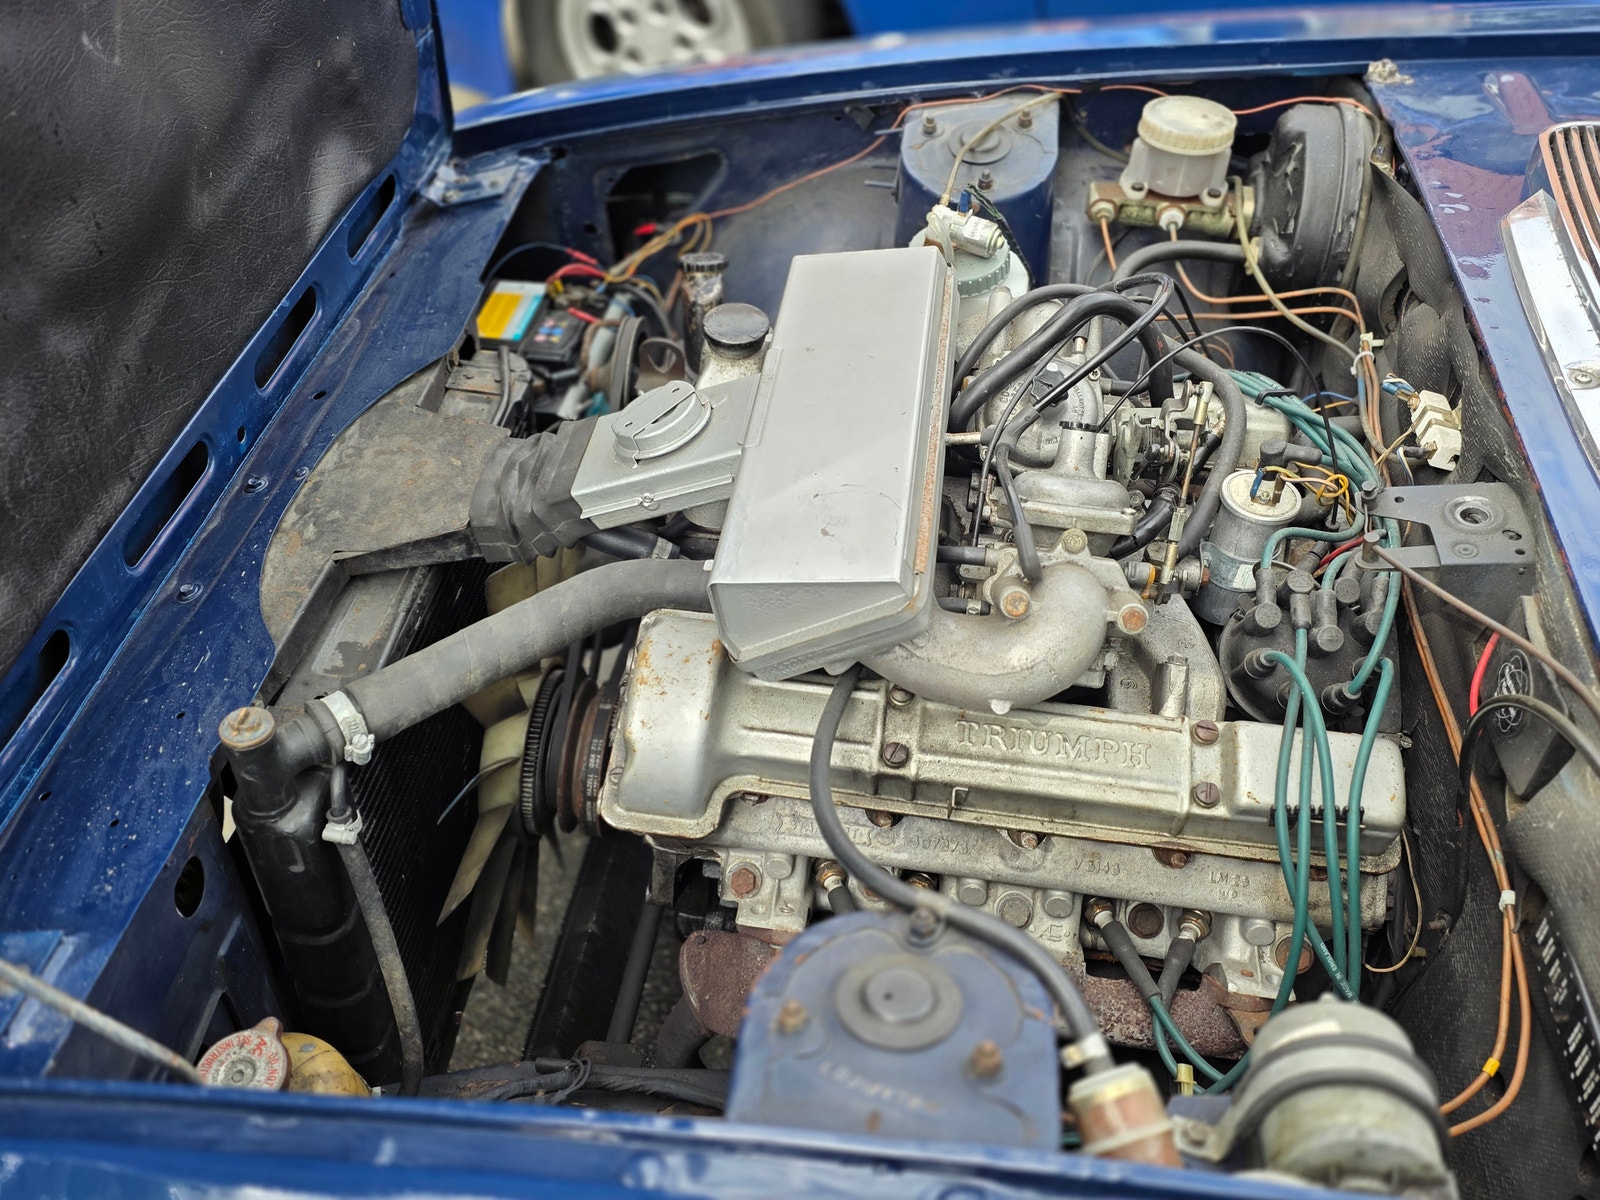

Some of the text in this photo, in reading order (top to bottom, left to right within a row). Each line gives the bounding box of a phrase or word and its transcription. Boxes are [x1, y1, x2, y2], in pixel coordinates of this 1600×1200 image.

[954, 719, 1152, 770] TRIUMPH
[1320, 942, 1353, 998] MADE IN ENGLAND
[236, 1034, 252, 1046] SEE
[252, 1036, 267, 1059] AC
